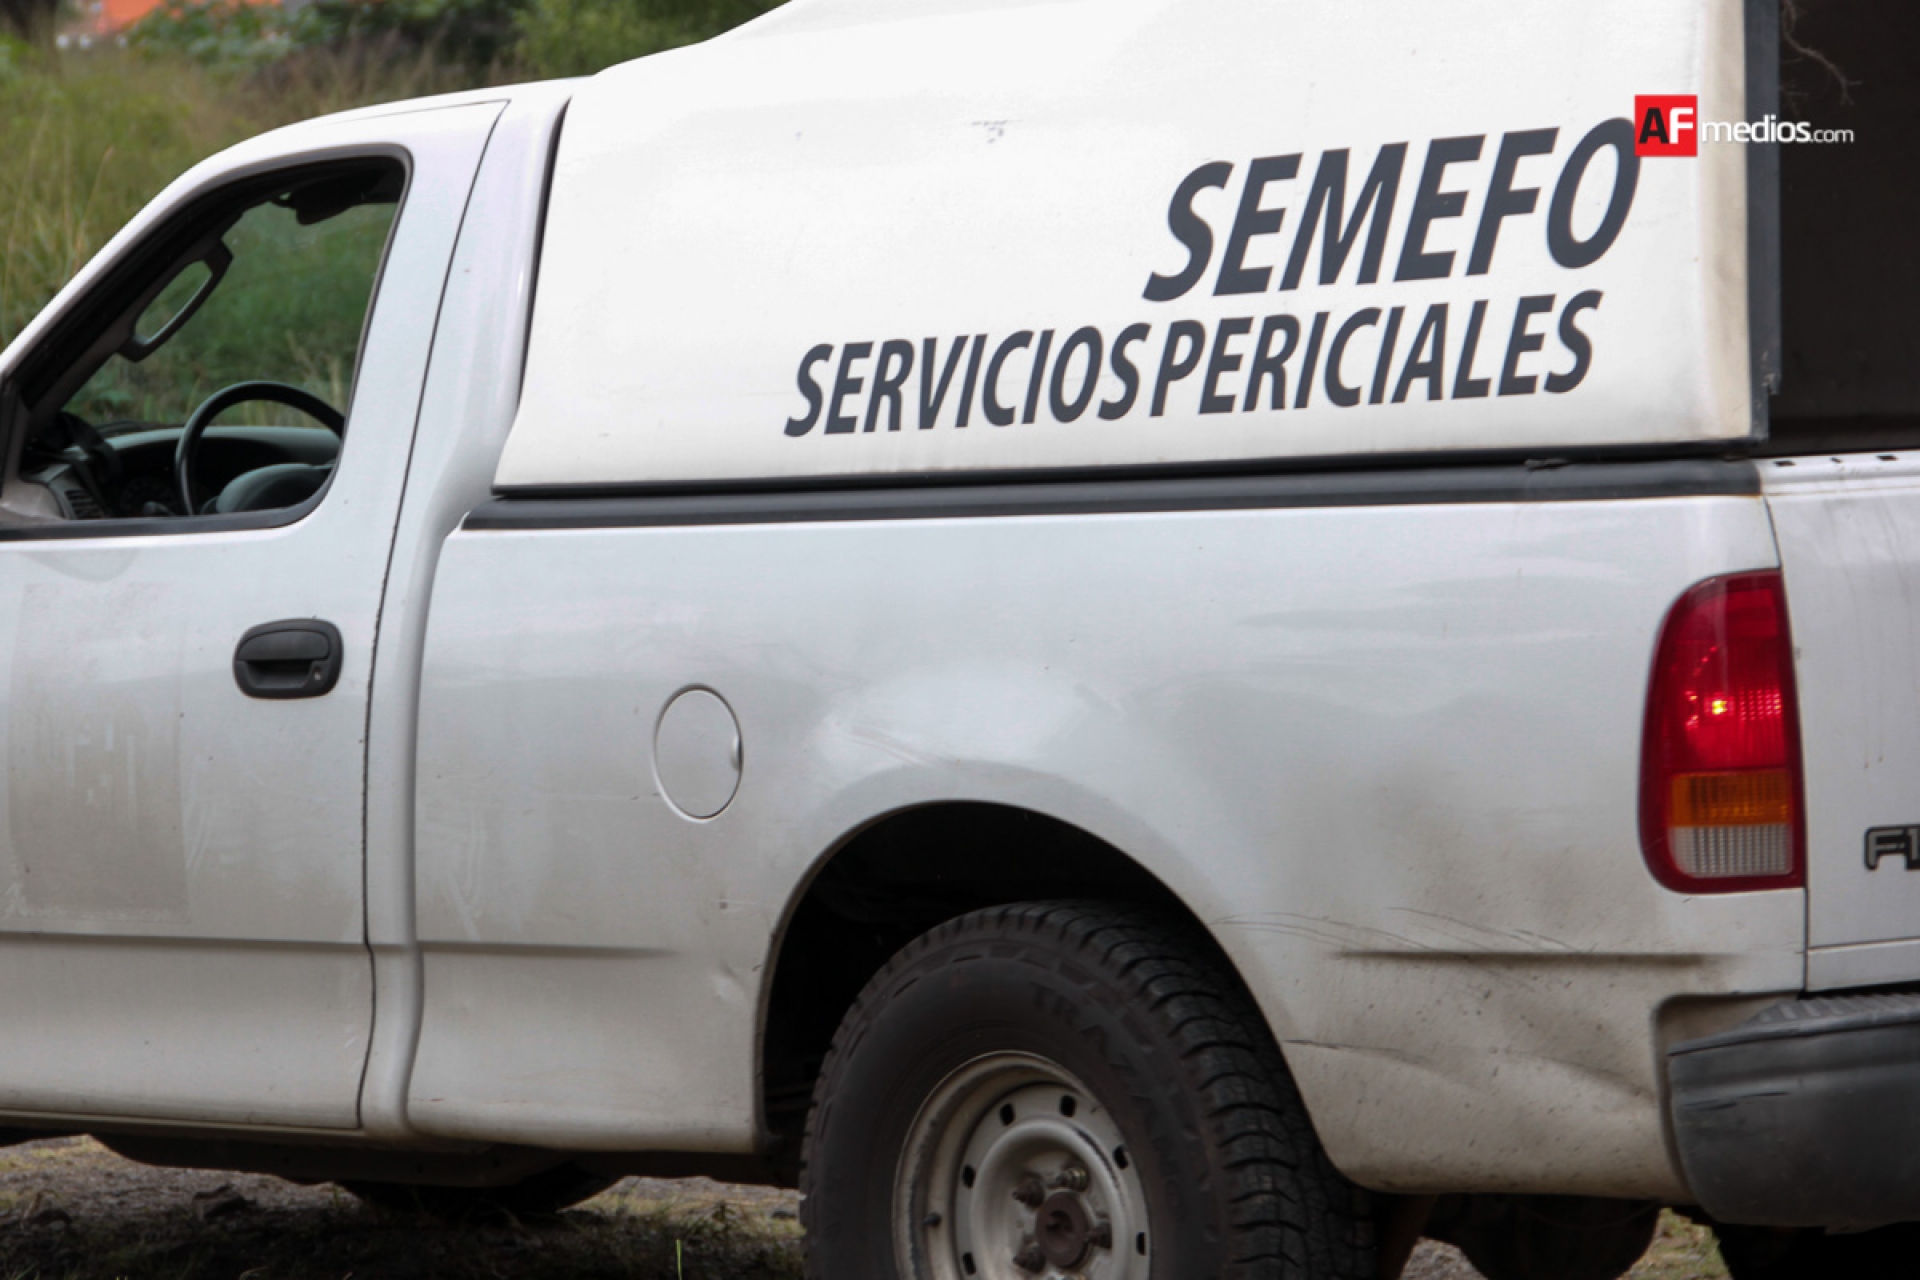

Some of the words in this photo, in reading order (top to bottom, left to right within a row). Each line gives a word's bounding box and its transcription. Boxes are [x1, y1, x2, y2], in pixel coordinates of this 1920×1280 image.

[1142, 116, 1641, 302] SEMEFO
[783, 322, 1152, 438] SERVICIOS
[1148, 289, 1604, 418] PERICIALES
